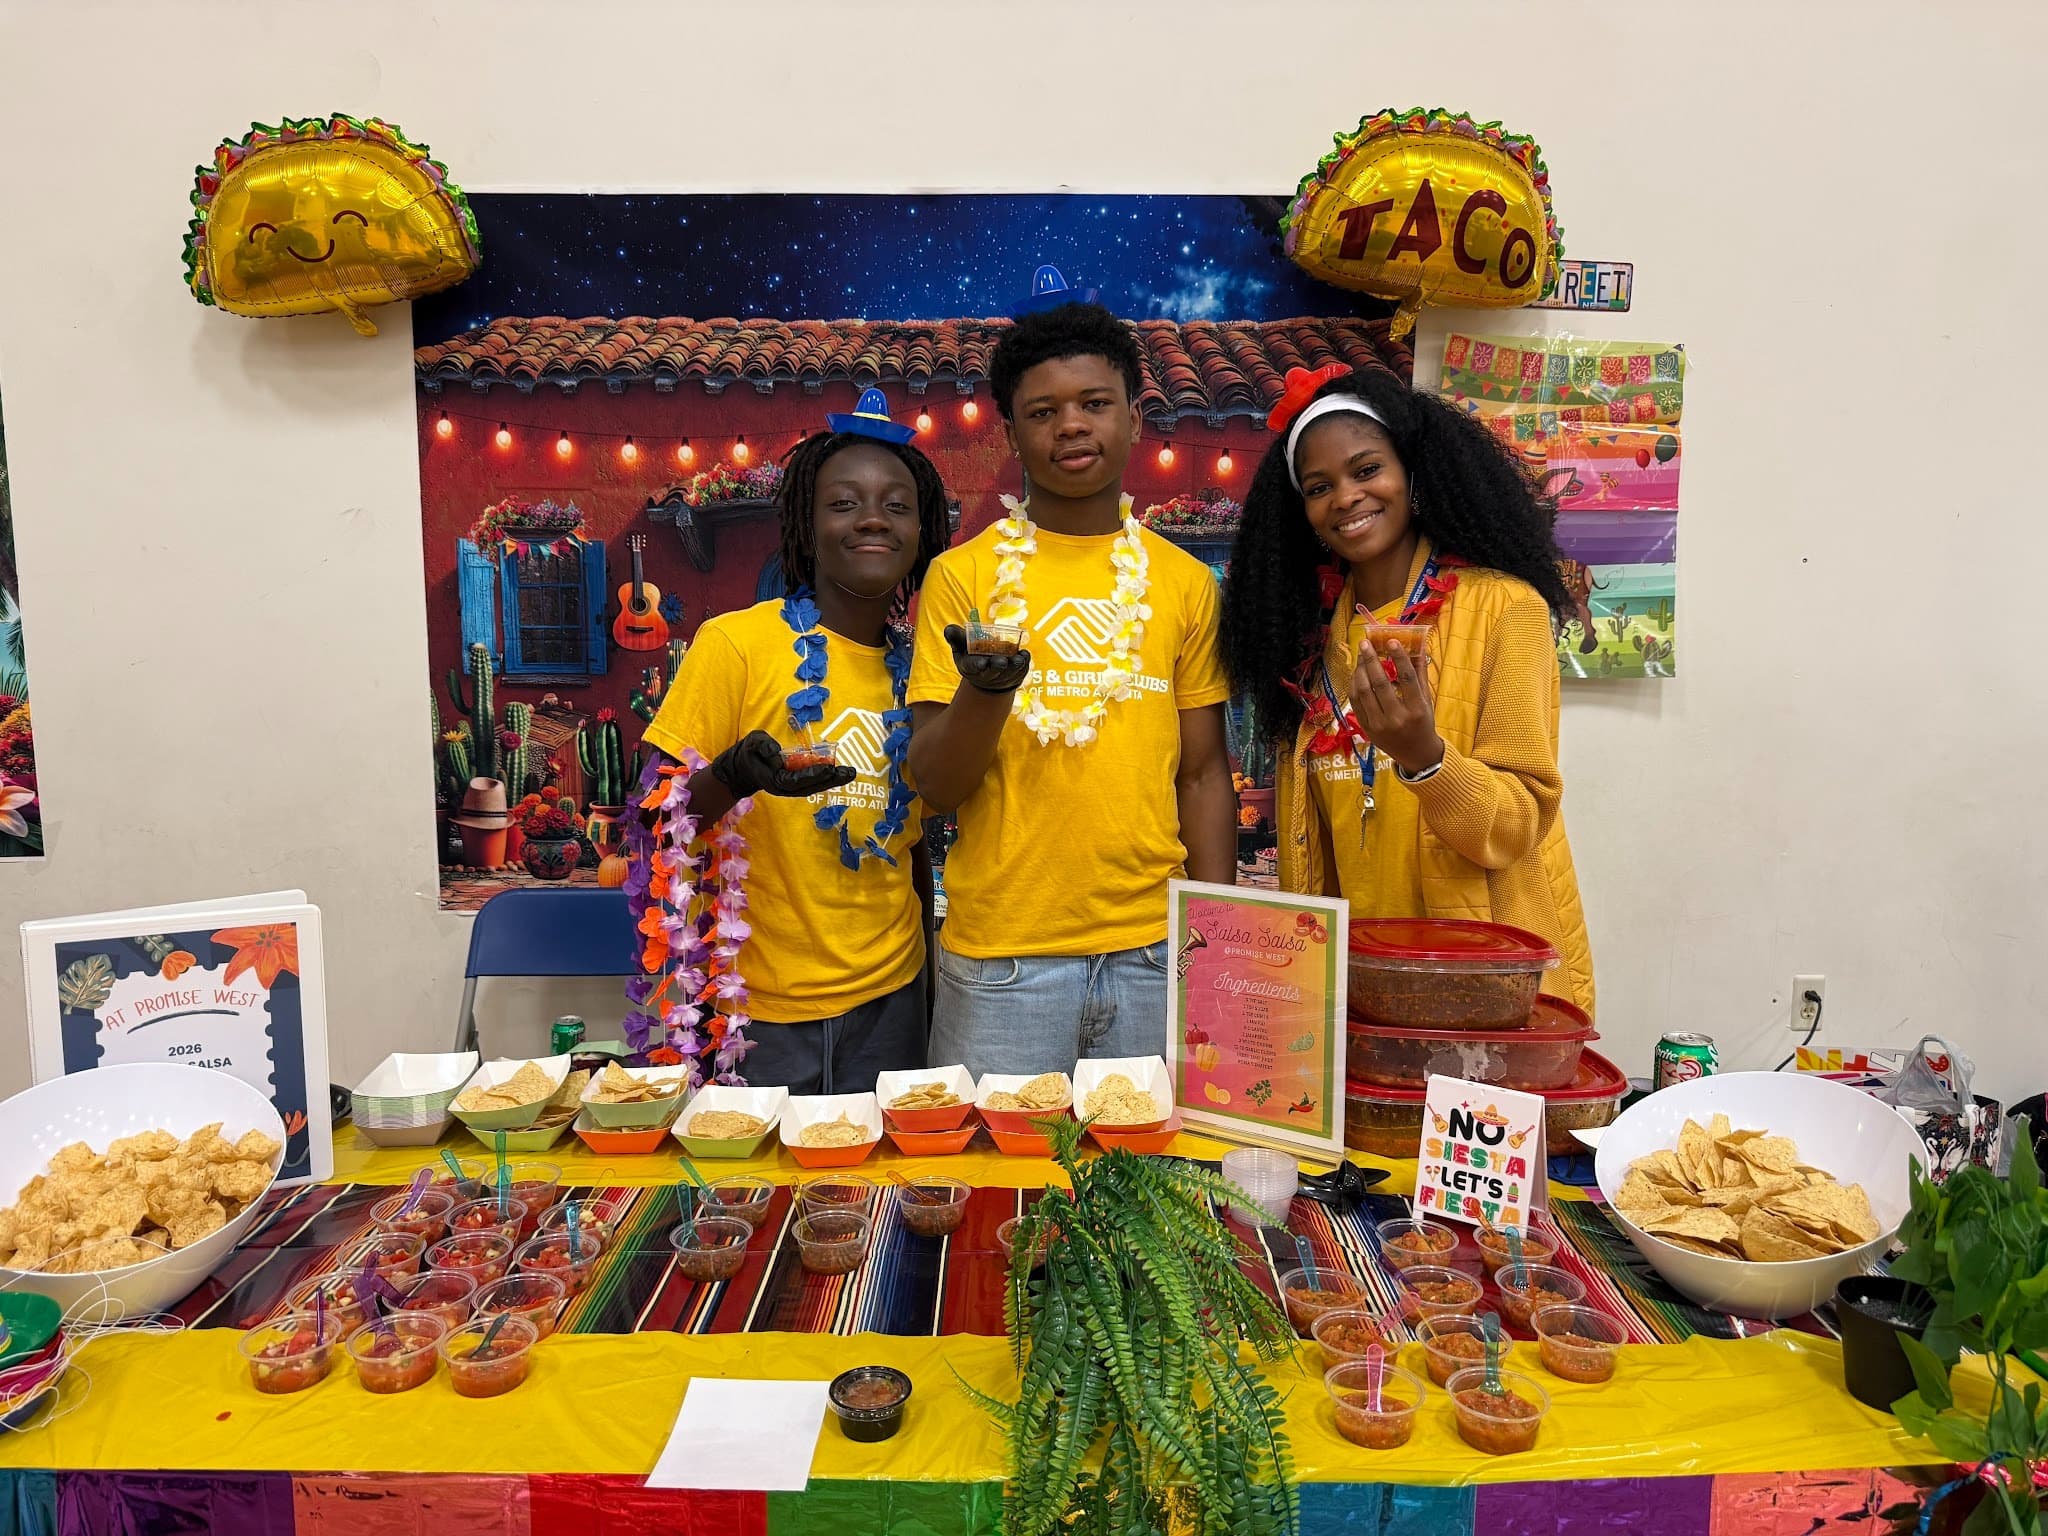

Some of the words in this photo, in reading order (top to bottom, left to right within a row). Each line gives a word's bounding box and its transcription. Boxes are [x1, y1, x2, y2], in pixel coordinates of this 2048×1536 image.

[1337, 178, 1536, 288] TACO
[1046, 670, 1061, 684] &
[1029, 686, 1043, 696] OF
[1047, 686, 1091, 697] METRO
[1332, 754, 1347, 768] &
[807, 794, 825, 804] OF
[827, 792, 867, 808] METRO
[845, 781, 886, 798] GIRLS
[1226, 903, 1234, 912] to
[1206, 919, 1253, 944] Salsa
[1258, 927, 1307, 952] Salsa
[1266, 952, 1286, 962] WEST
[1213, 971, 1300, 1000] Ingredients
[105, 1008, 127, 1031] AT
[134, 989, 203, 1016] PROMISE
[214, 989, 260, 1007] WEST
[168, 1043, 202, 1057] 2026
[1449, 1107, 1505, 1145] NO
[1425, 1137, 1526, 1180] SIESTA
[1441, 1166, 1504, 1199] LET'S
[1419, 1184, 1521, 1224] FIESTA
